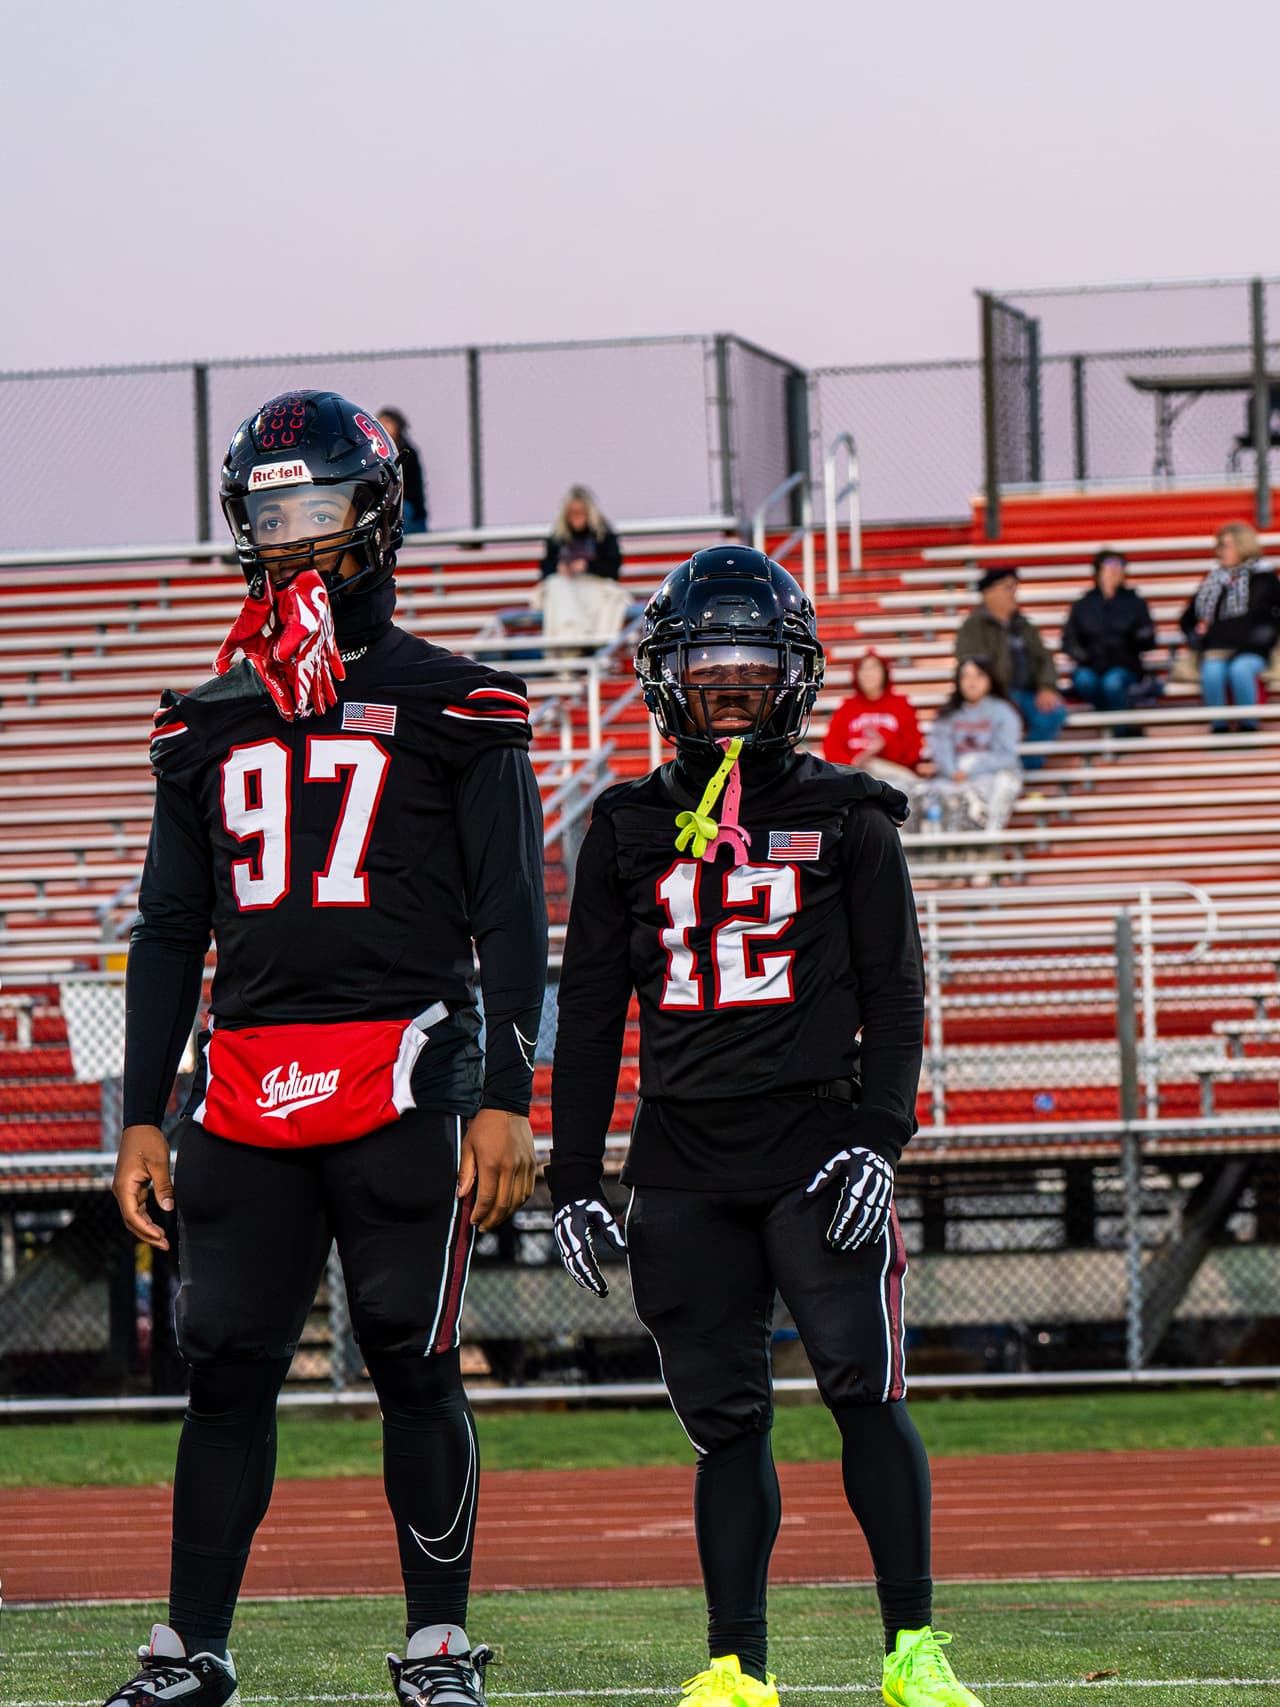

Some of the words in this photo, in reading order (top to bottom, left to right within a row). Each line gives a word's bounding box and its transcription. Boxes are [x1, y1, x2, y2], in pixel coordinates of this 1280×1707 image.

[219, 735, 392, 912] 97
[656, 858, 802, 1011] 12
[256, 1061, 341, 1119] Indiana
